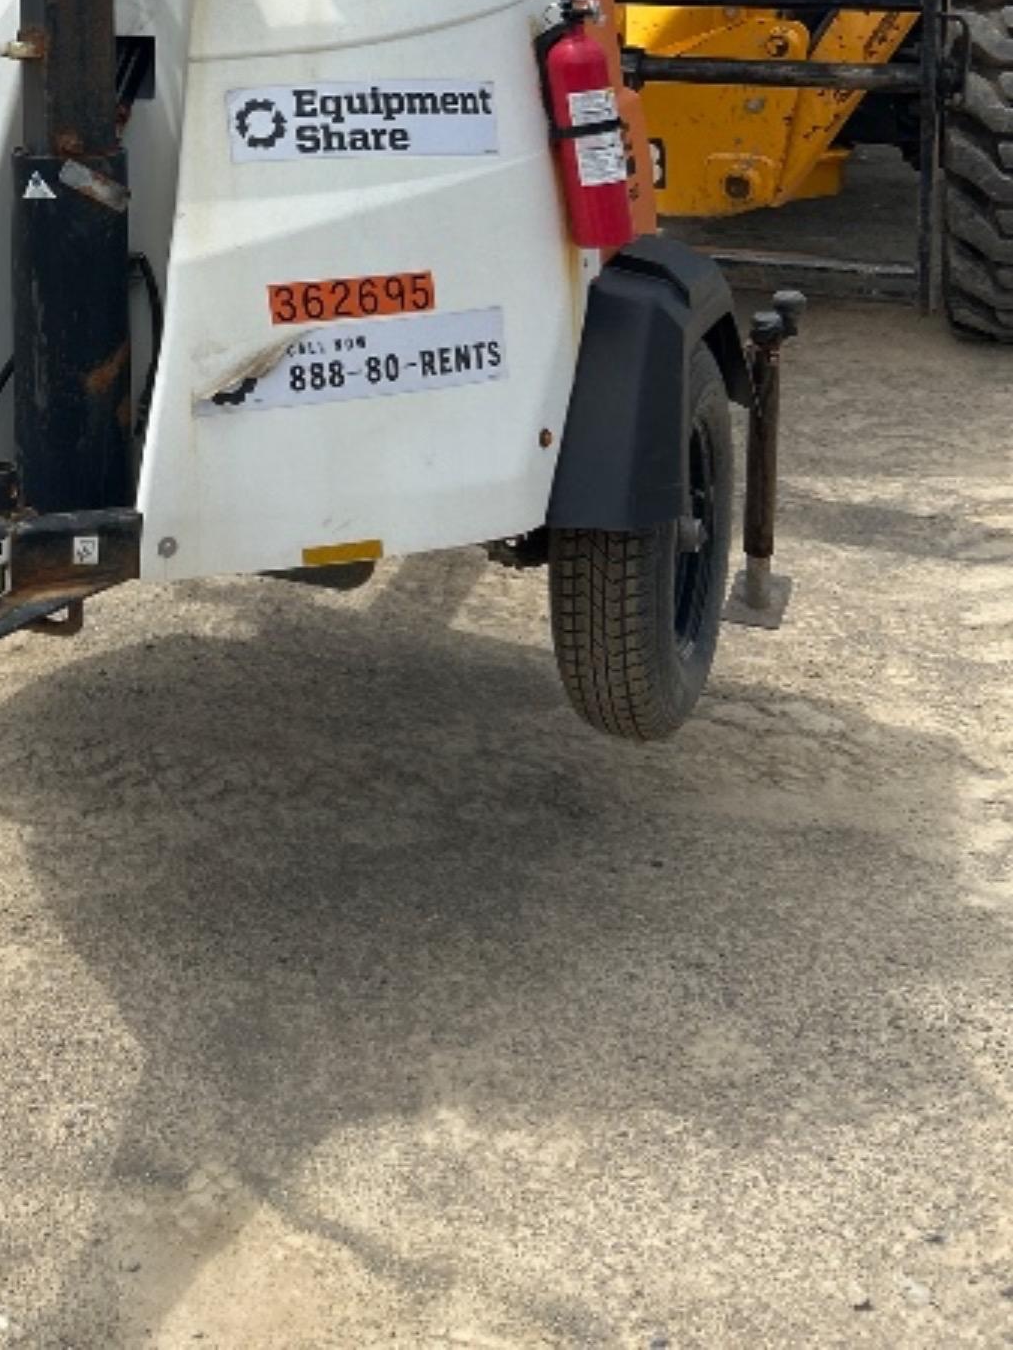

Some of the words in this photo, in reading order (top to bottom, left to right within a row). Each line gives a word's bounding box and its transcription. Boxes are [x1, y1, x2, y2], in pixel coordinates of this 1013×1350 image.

[291, 86, 493, 124] Equipment
[294, 124, 411, 153] Share
[273, 274, 431, 323] 362695
